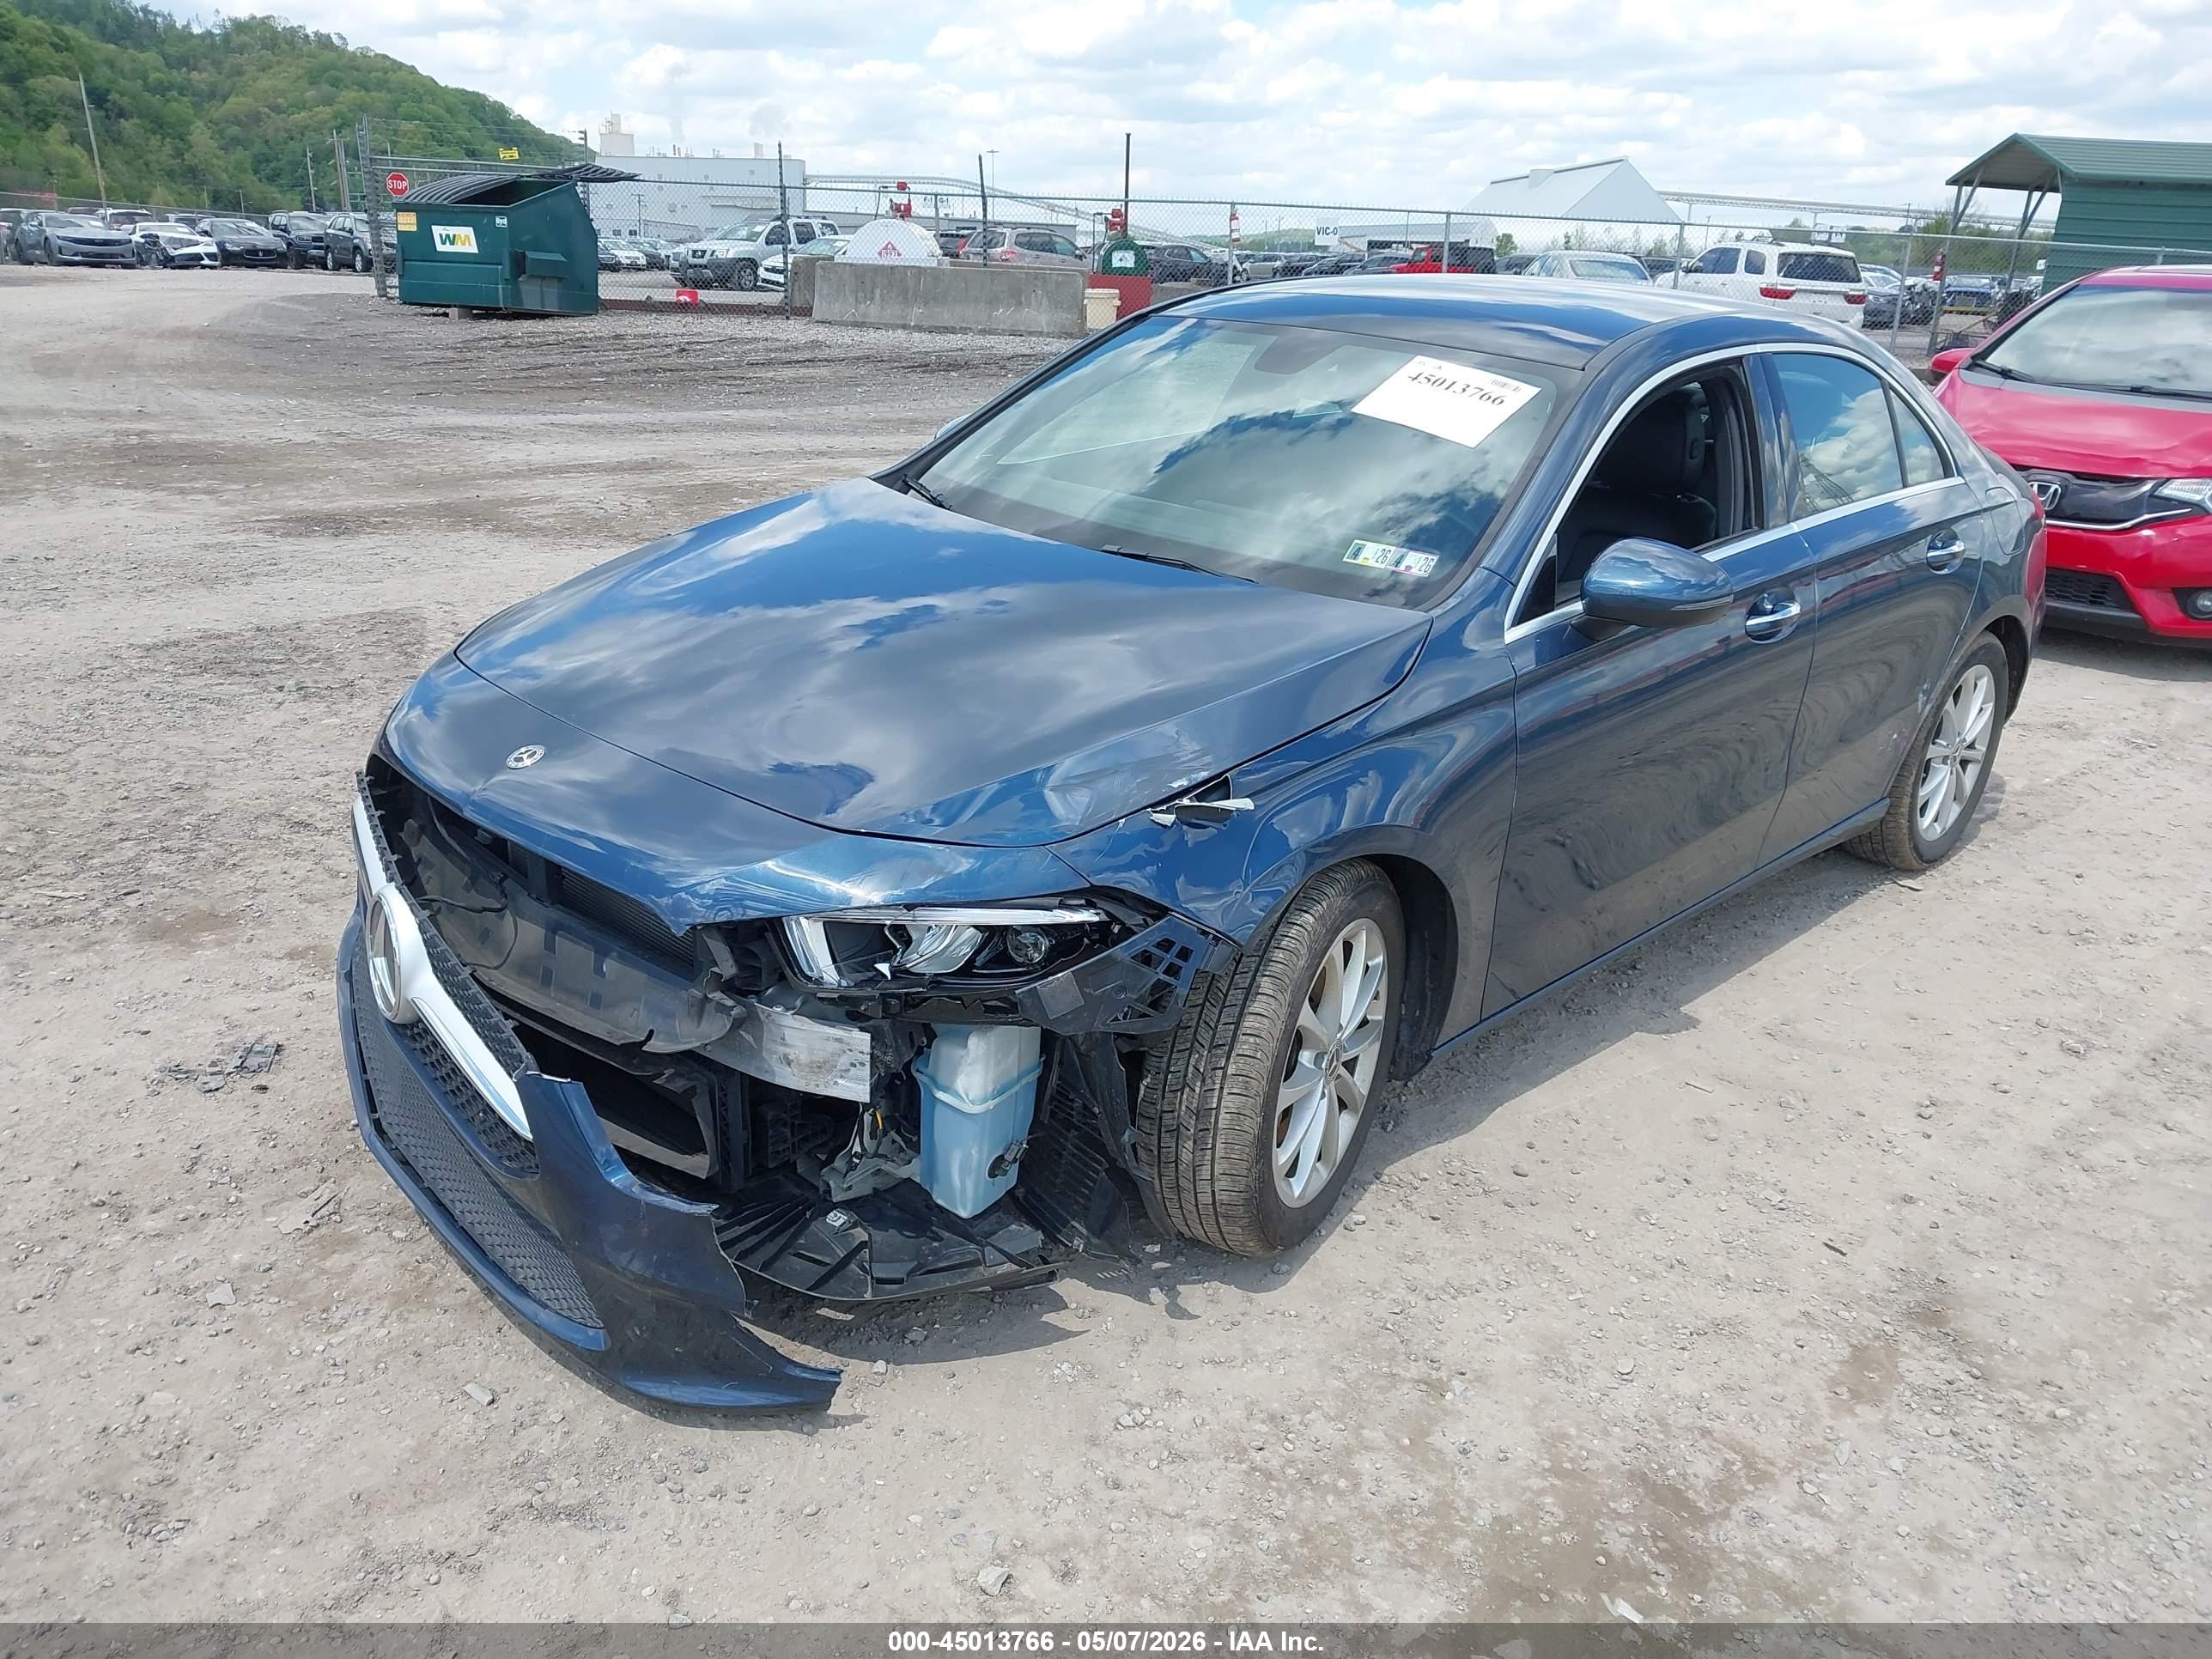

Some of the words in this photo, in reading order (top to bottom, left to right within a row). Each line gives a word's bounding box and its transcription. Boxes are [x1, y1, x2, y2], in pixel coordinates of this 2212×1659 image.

[388, 179, 407, 190] STOP
[439, 233, 471, 246] WM
[1408, 371, 1505, 406] 45013766
[1351, 547, 1361, 560] 4
[1376, 549, 1391, 564] 26
[1393, 554, 1405, 568] 4
[1419, 556, 1434, 573] 26
